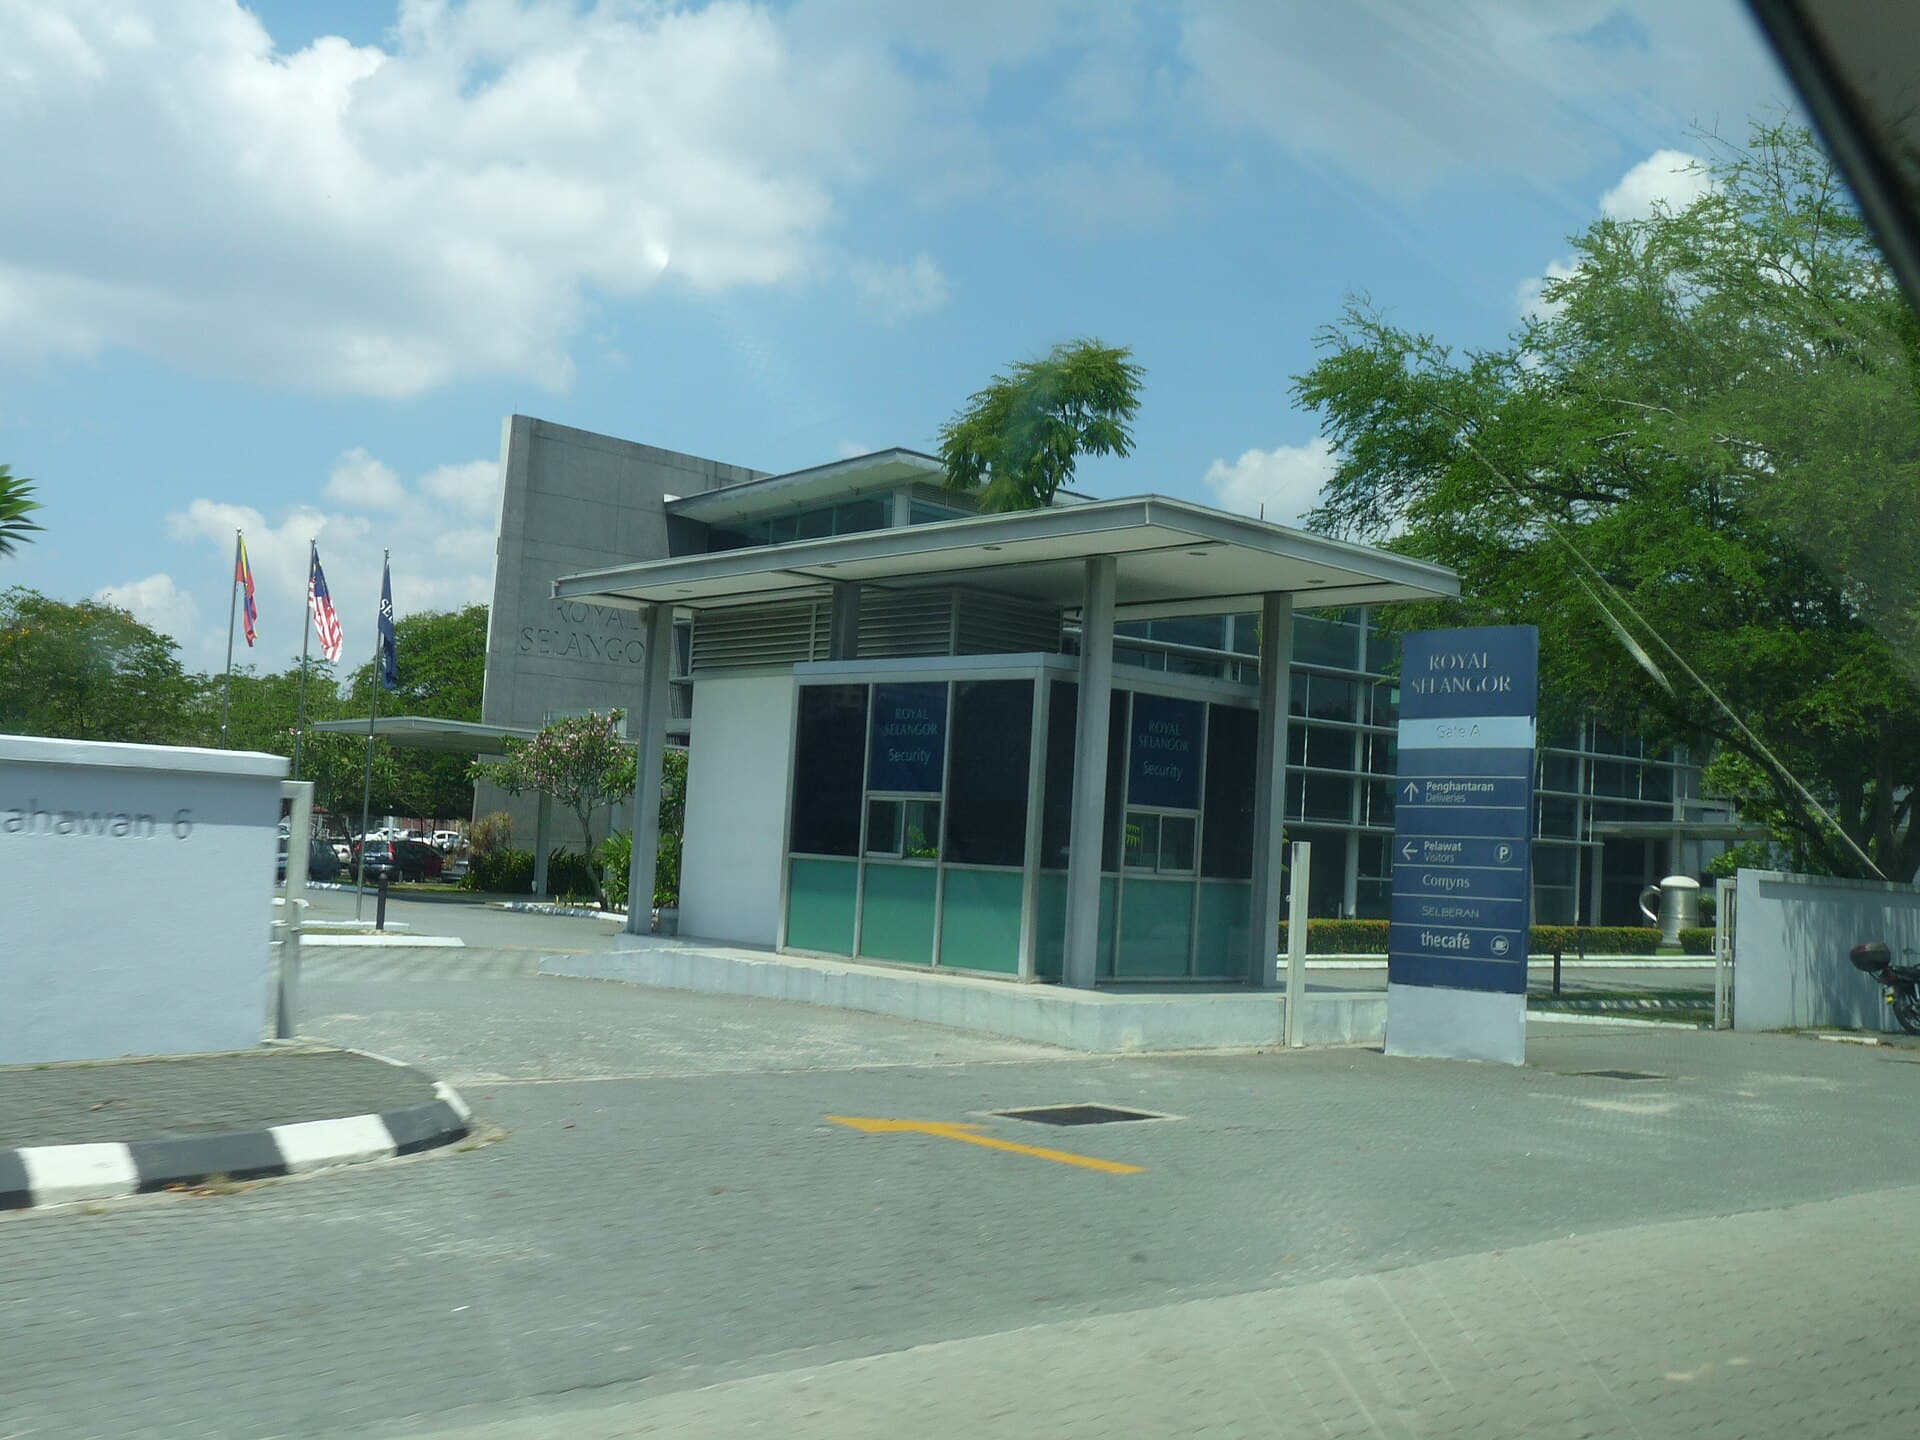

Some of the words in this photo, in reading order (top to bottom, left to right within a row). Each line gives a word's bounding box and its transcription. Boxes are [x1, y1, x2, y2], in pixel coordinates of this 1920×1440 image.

[1429, 652, 1488, 671] ROYAL
[1411, 675, 1513, 695] SELANGOR
[1436, 723, 1465, 739] Gate
[1469, 723, 1481, 737] A
[888, 747, 931, 768] Security
[1143, 760, 1182, 782] Security
[1426, 781, 1494, 794] Penghantaran
[1425, 793, 1466, 803] Deliveries
[174, 808, 192, 839] 6
[1423, 840, 1462, 852] Pelawat
[1500, 847, 1508, 859] P
[1424, 852, 1455, 863] Visitors
[1422, 874, 1470, 890] Comyns
[1421, 905, 1480, 919] SELBERAN
[1421, 930, 1471, 949] thecafé
